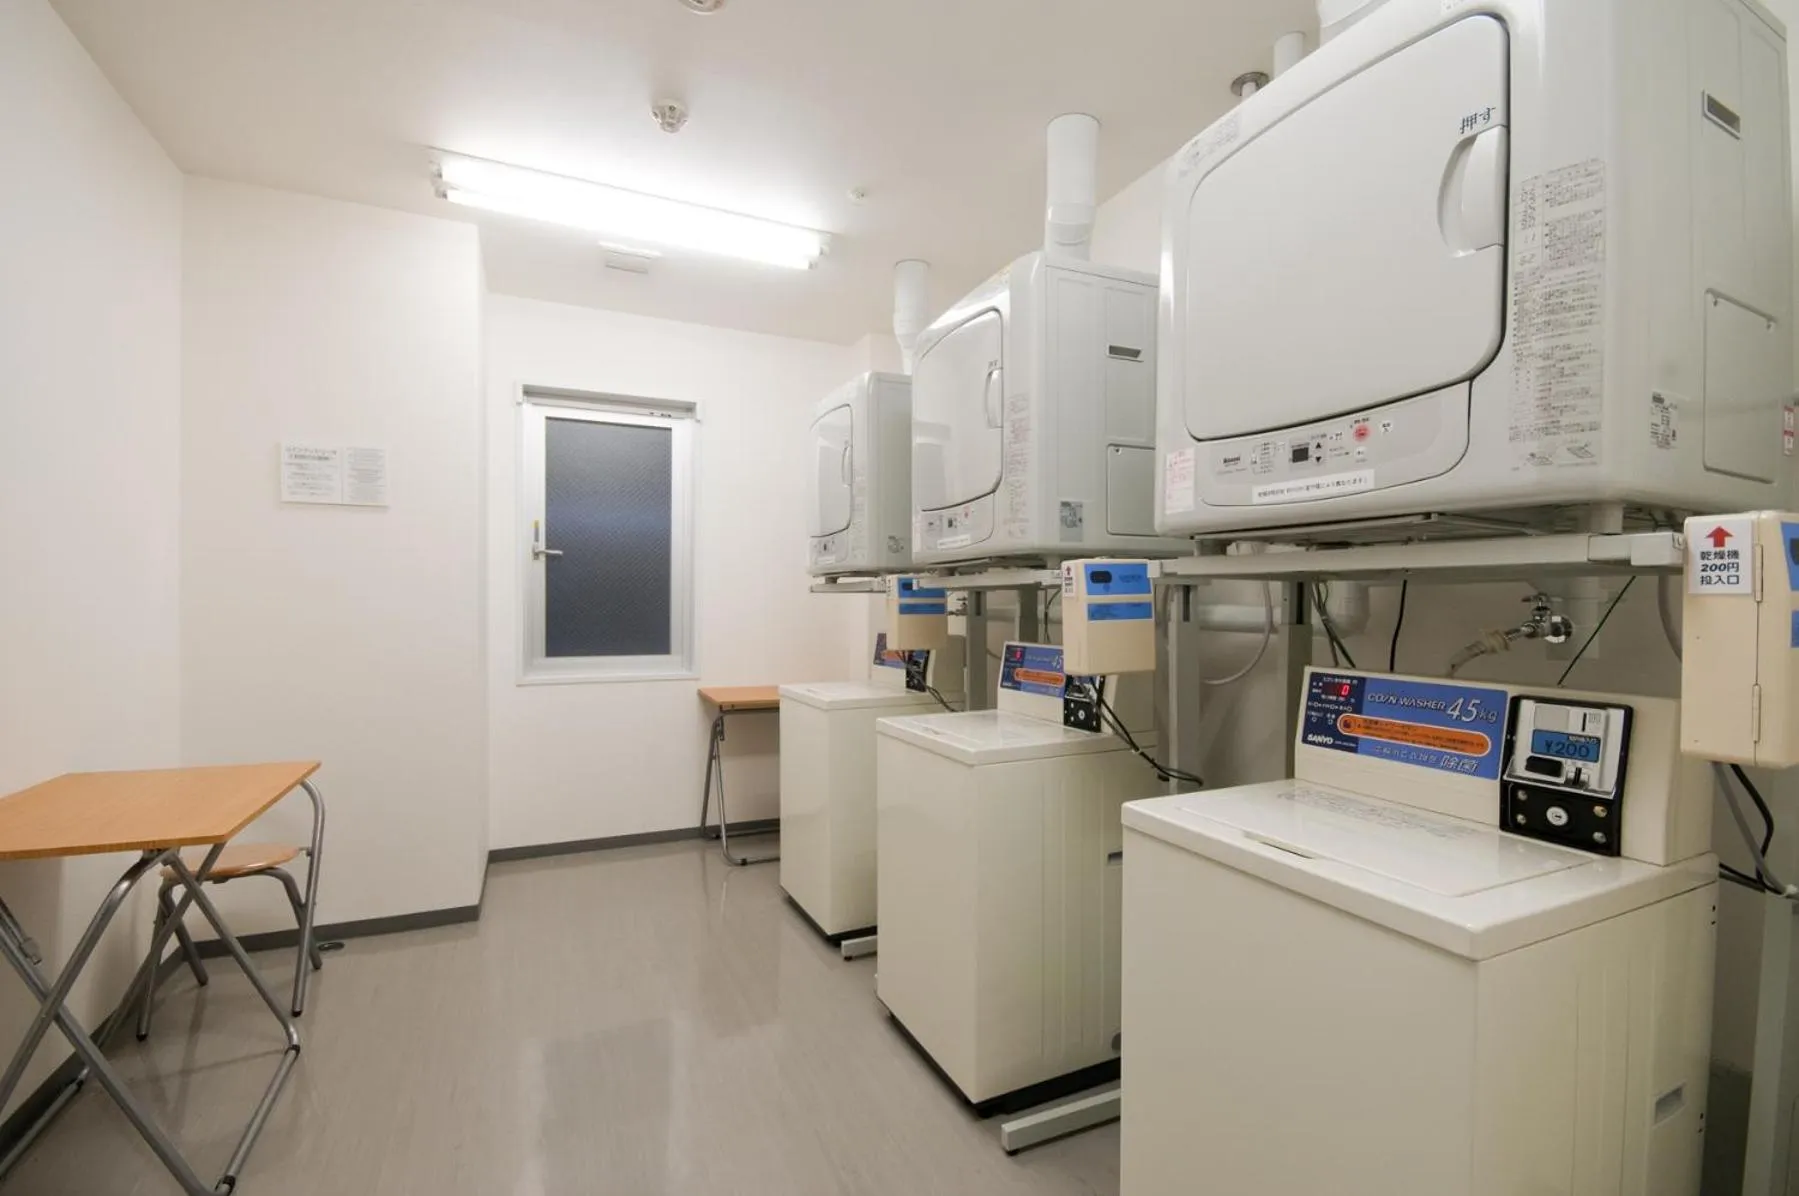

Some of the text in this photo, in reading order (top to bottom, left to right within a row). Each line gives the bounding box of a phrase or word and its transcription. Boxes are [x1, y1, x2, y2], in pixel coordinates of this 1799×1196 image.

[1460, 106, 1496, 134] 押す
[1700, 550, 1740, 561] 乾燥機
[1700, 562, 1740, 573] 200円
[1700, 575, 1740, 585] 投入口
[1399, 697, 1446, 710] WASHER
[1306, 733, 1334, 745] SANYO
